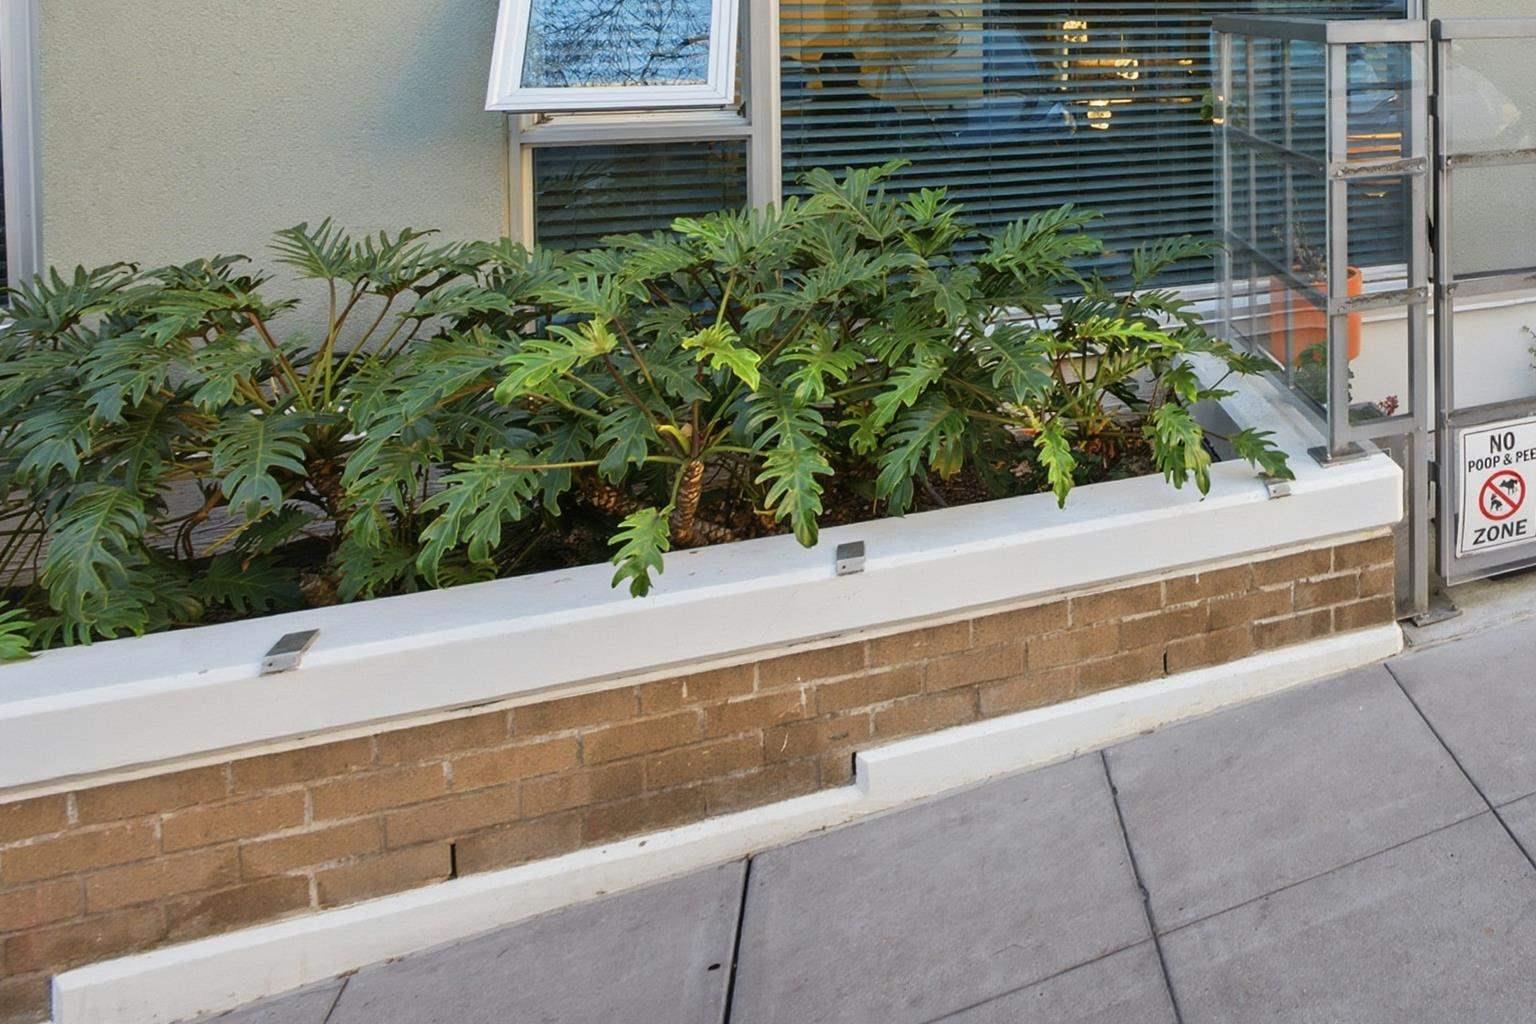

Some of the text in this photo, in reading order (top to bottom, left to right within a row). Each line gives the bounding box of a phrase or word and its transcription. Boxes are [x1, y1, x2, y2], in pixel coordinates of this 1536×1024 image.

[1490, 431, 1516, 454] NO
[1468, 447, 1536, 472] POOP & PEE
[1472, 519, 1528, 545] ZONE
